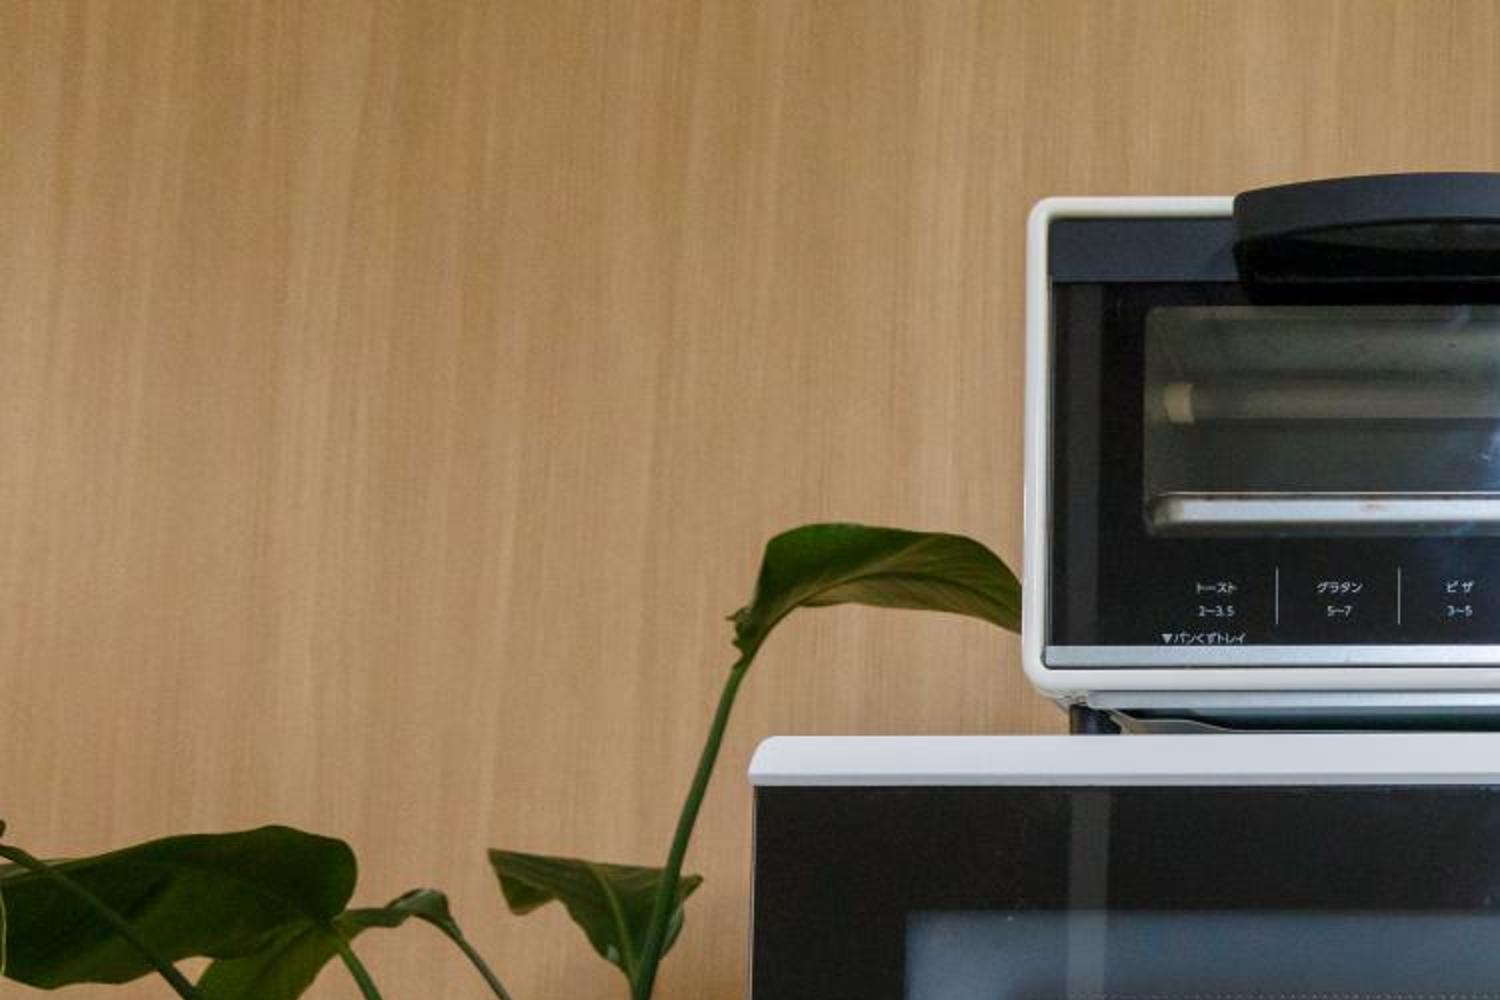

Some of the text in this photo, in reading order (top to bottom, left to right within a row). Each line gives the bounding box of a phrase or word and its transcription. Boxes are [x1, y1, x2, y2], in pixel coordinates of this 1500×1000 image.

[1197, 582, 1237, 594] トースト
[1316, 582, 1363, 594] グラタン
[1446, 580, 1475, 593] ピザ
